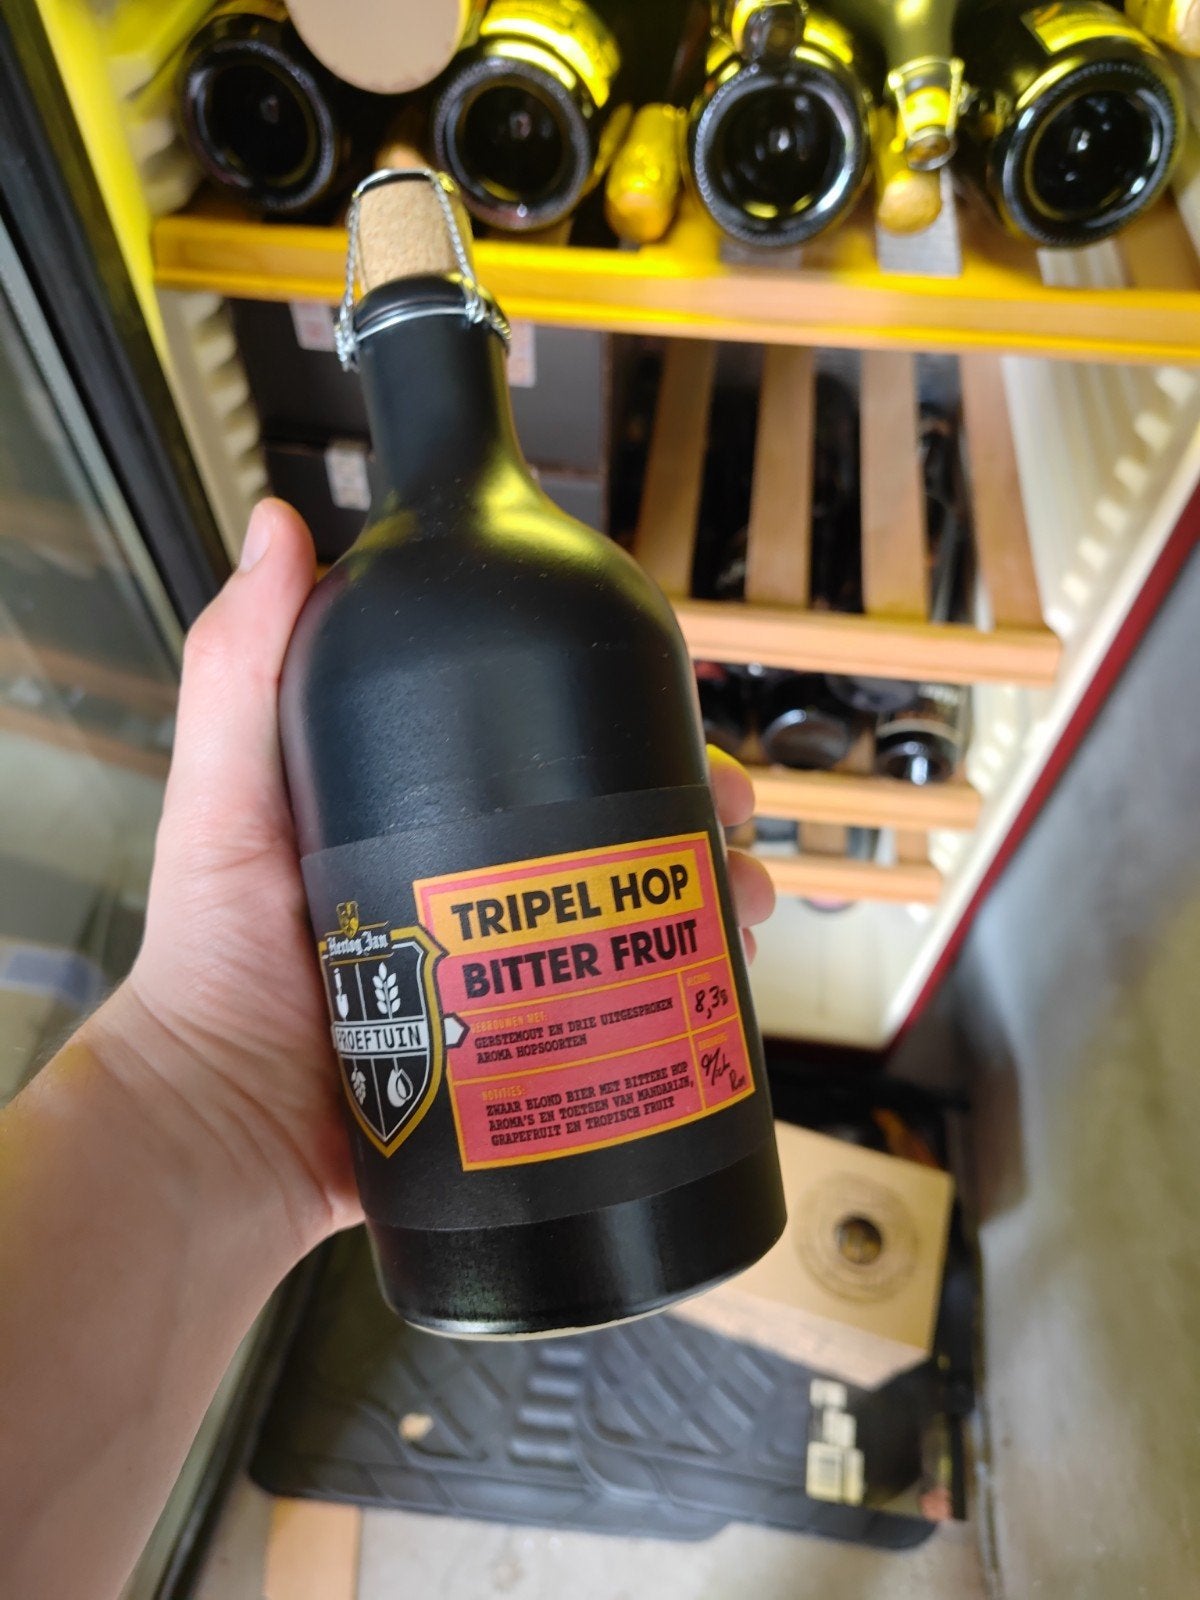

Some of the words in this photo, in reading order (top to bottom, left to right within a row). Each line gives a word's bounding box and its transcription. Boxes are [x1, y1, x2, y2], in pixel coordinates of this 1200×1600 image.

[451, 881, 602, 941] TRIPEL
[610, 864, 688, 912] HOP
[462, 943, 601, 999] BITTER
[610, 919, 697, 972] FRUIT
[474, 1027, 544, 1049] GERSTEMOUT
[548, 1022, 563, 1036] EN
[568, 1017, 597, 1032] DRIE
[600, 997, 674, 1026] UITGESPROKEN
[477, 1048, 512, 1065] AROMA
[516, 1033, 588, 1058] HOPSOORTEN
[486, 1100, 522, 1117] ZWAAR
[526, 1093, 562, 1111] BLOND
[566, 1086, 596, 1103] BIER
[600, 1080, 621, 1096] MET
[625, 1067, 668, 1090] BITTERE
[671, 1061, 689, 1076] HOP
[489, 1115, 535, 1132] AROMA'S
[540, 1109, 555, 1123] EN
[559, 1100, 609, 1119] TOETSEN
[613, 1091, 634, 1107] VAN
[491, 1125, 561, 1147] GRAPEFRUIT
[566, 1120, 582, 1133] EN
[585, 1107, 641, 1130] TROPISCH
[644, 1095, 675, 1115] FRUIT
